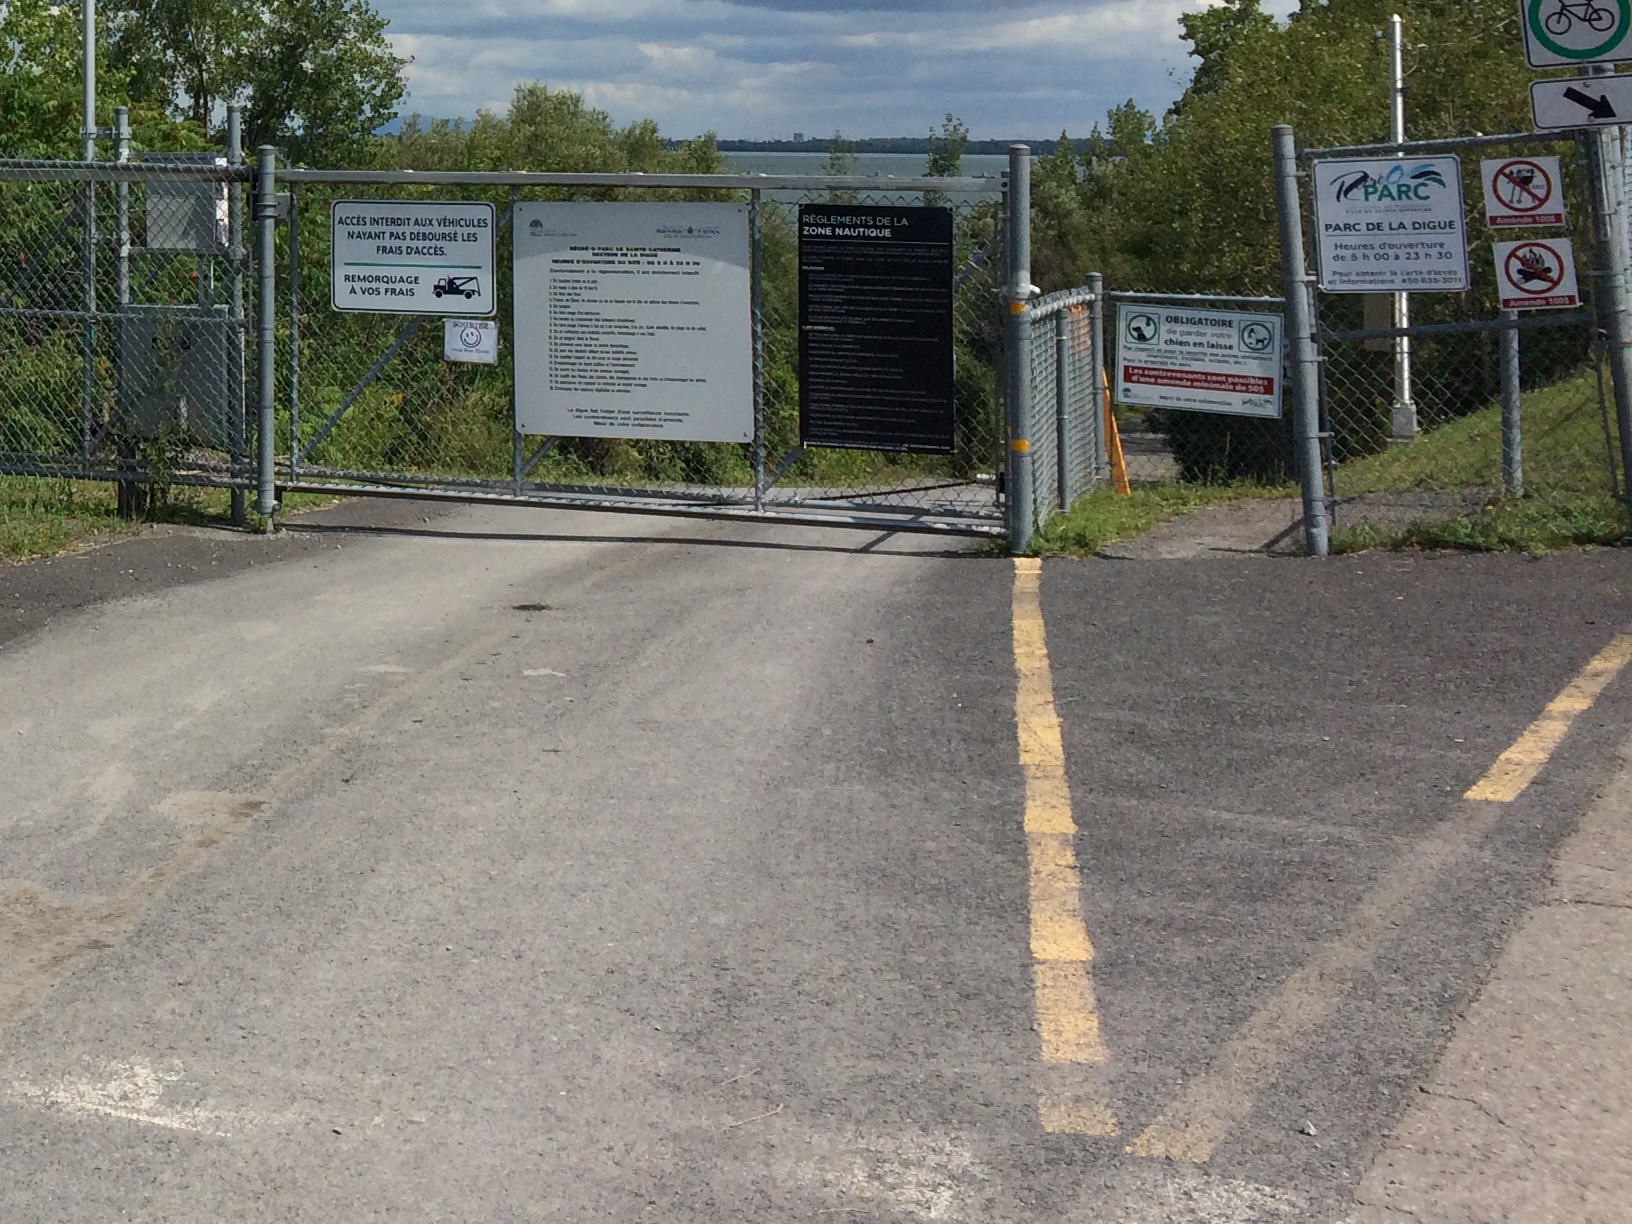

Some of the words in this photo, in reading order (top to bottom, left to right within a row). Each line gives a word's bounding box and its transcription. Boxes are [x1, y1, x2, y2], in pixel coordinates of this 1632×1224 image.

[1363, 182, 1430, 201] PARC
[337, 214, 367, 226] ACCÈS
[369, 216, 411, 227] INTERDIT
[413, 217, 434, 227] AUX
[436, 215, 488, 228] VÉHICULES
[802, 214, 873, 225] RÈGLEMENTS
[876, 217, 891, 226] DE
[894, 217, 909, 226] LA
[1325, 223, 1362, 232] PARC
[1366, 222, 1384, 232] DE
[1388, 221, 1407, 231] LA
[1412, 220, 1456, 230] DIGUE
[347, 231, 386, 241] N'AYANT
[389, 231, 407, 242] PAS
[409, 229, 458, 242] DÉBOURSÉ
[461, 232, 478, 243] LES
[802, 226, 832, 235] ZONE
[835, 227, 892, 237] NAUTIQUE
[376, 245, 403, 255] FRAIS
[406, 244, 447, 256] D'ACCÈS.
[1334, 242, 1375, 251] Heures
[1378, 241, 1445, 250] d'ouverture
[1332, 253, 1346, 262] de
[1362, 253, 1369, 261] h
[1373, 252, 1390, 261] 00
[1405, 252, 1421, 260] 23
[1425, 252, 1432, 260] h
[1437, 251, 1453, 260] 30
[344, 274, 420, 285] REMORQUAGE
[349, 284, 357, 295] À
[360, 287, 381, 296] VOS
[384, 287, 415, 297] FRAIS
[1165, 315, 1233, 328] OBLIGATOIRE
[1166, 328, 1177, 336] de
[1164, 338, 1190, 347] chien
[1193, 340, 1204, 348] en
[1207, 340, 1233, 351] laisse
[1129, 366, 1142, 375] Les
[1144, 368, 1206, 380] contrevenants
[1207, 373, 1226, 382] sont
[1228, 375, 1268, 386] passibles
[1193, 380, 1233, 391] minimale
[1235, 383, 1247, 392] de
